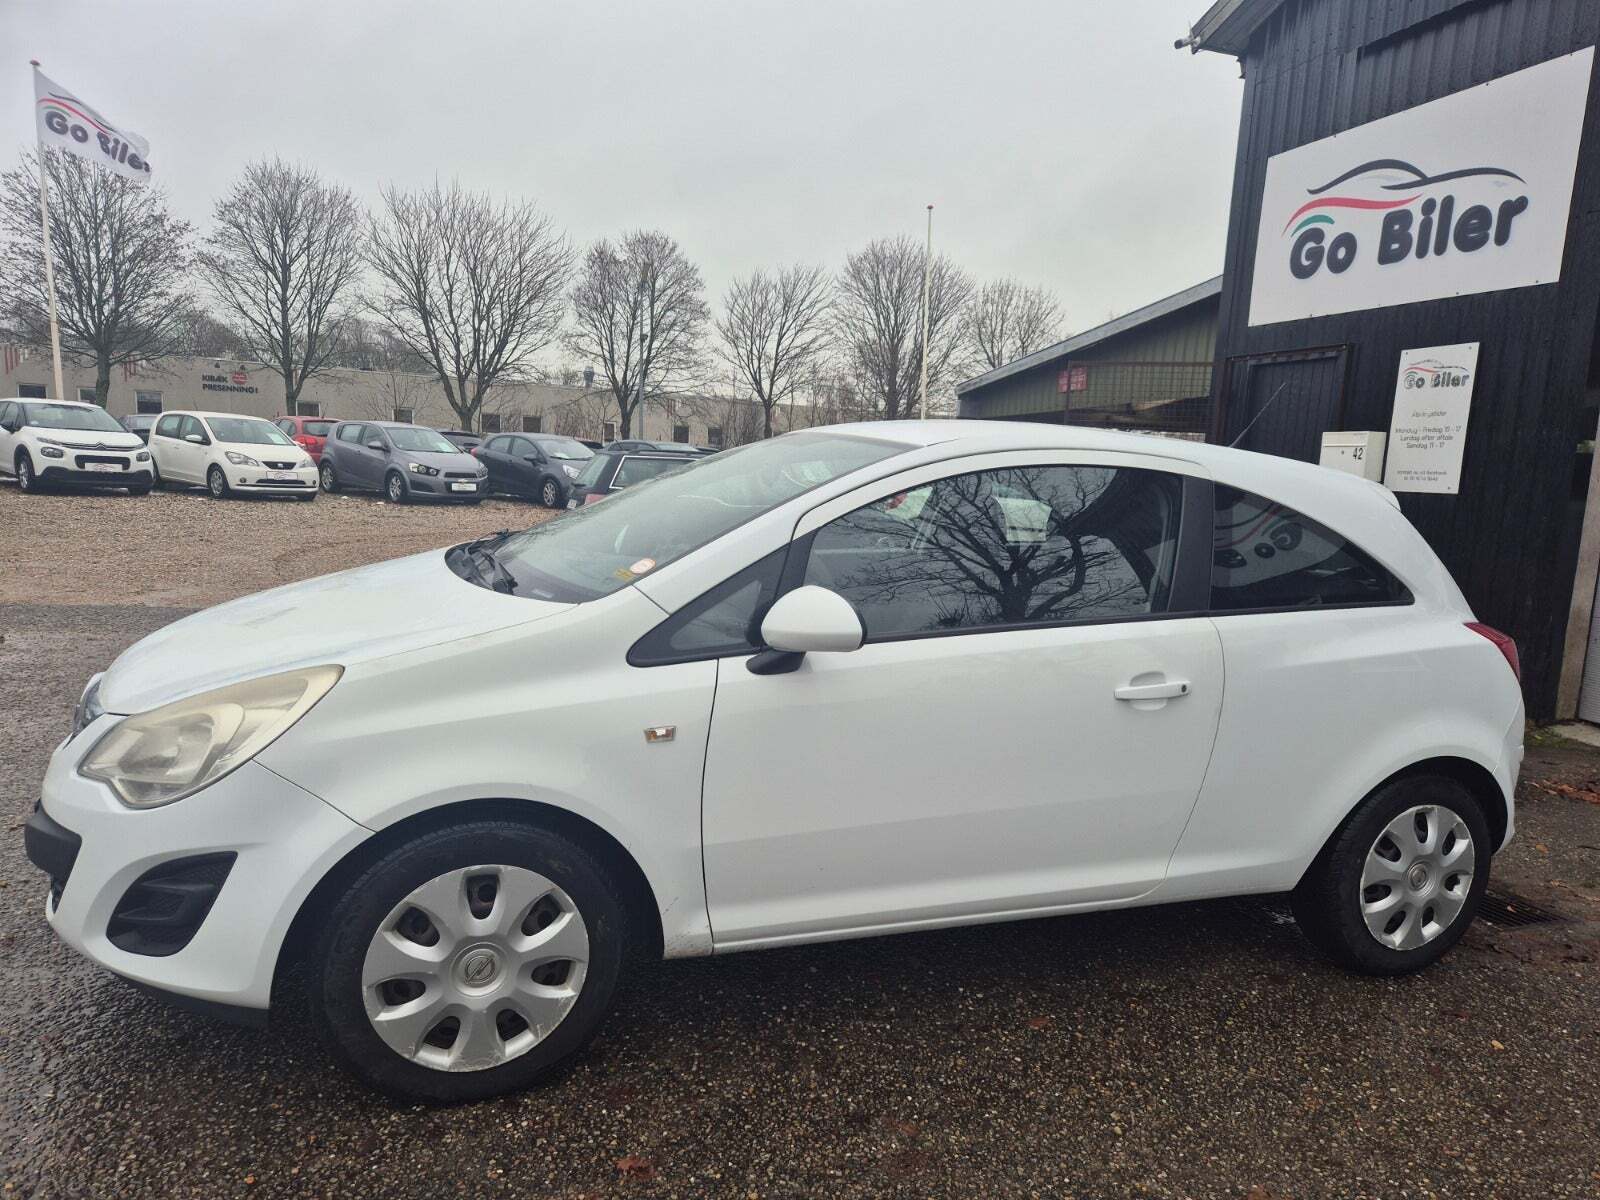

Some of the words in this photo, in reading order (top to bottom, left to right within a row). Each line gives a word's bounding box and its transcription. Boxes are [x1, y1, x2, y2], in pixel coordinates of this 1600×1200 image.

[45, 111, 88, 143] Go
[1290, 227, 1357, 279] Go
[1377, 194, 1529, 265] Biler
[1404, 375, 1425, 390] Go
[1431, 371, 1470, 388] Biler
[1353, 447, 1363, 460] 42
